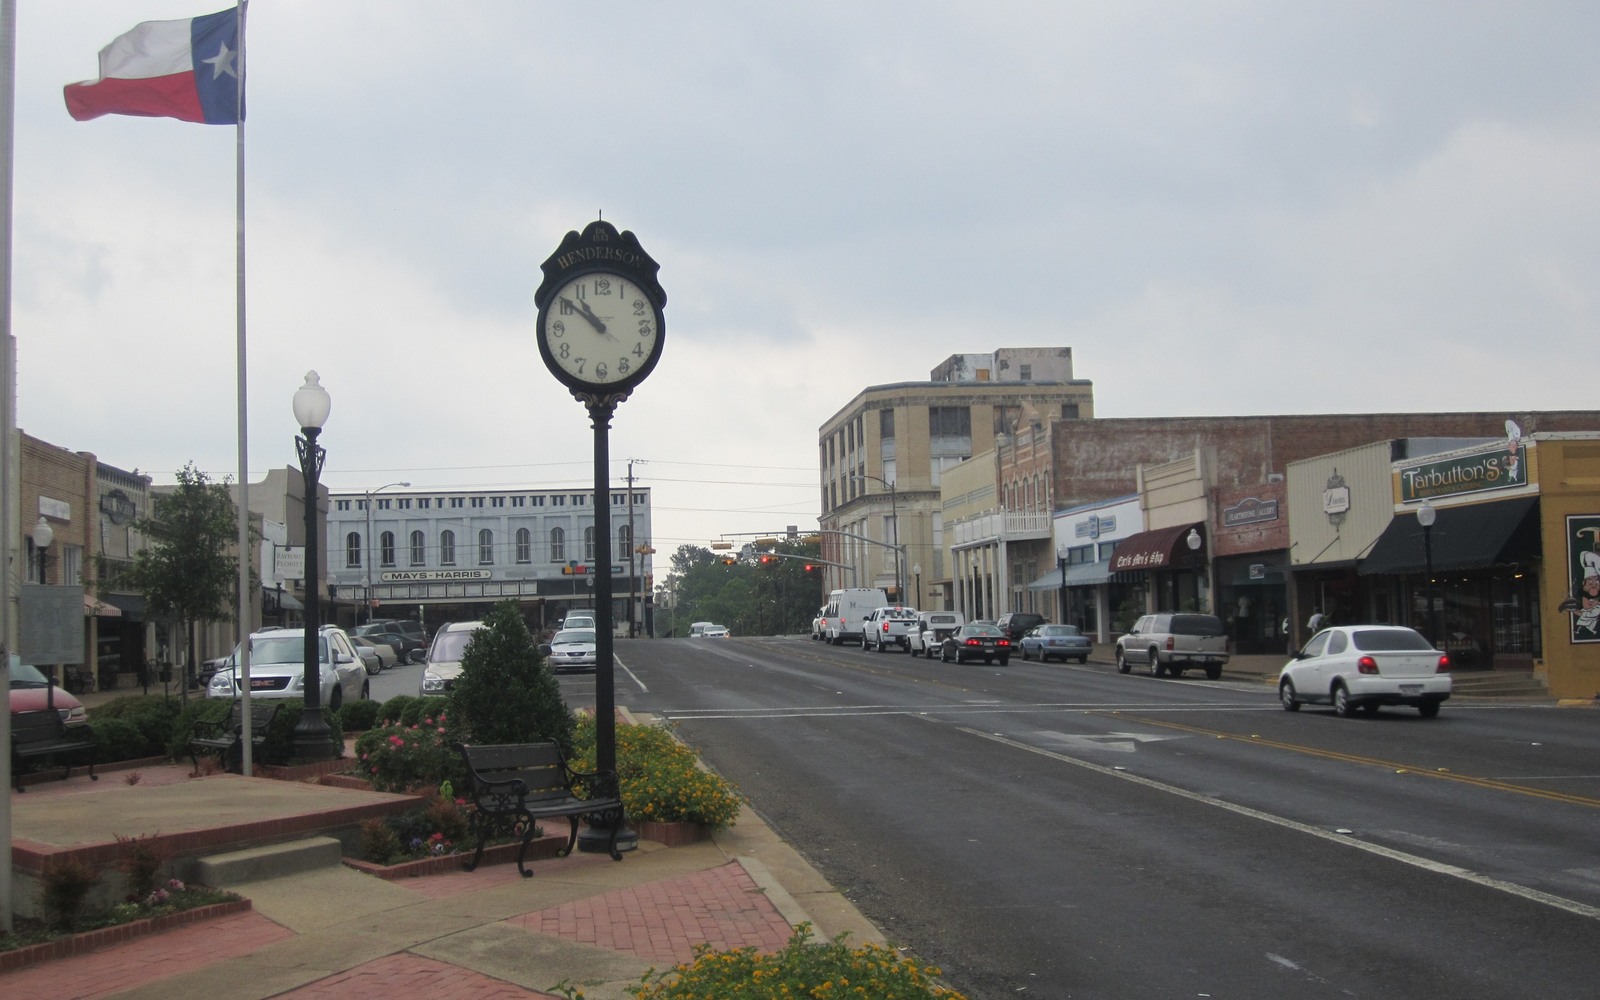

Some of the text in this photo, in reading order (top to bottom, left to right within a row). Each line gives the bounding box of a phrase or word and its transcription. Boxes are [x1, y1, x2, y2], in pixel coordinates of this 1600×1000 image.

[557, 246, 645, 269] HENDERSON
[575, 284, 586, 300] 11
[595, 280, 611, 296] 12
[620, 284, 624, 300] 1
[633, 300, 646, 316] 2
[553, 321, 565, 338] 9
[639, 320, 652, 336] 3
[559, 342, 570, 359] 8
[632, 342, 644, 358] 4
[575, 357, 587, 374] 7
[595, 362, 608, 379] 6
[618, 357, 630, 374] 5
